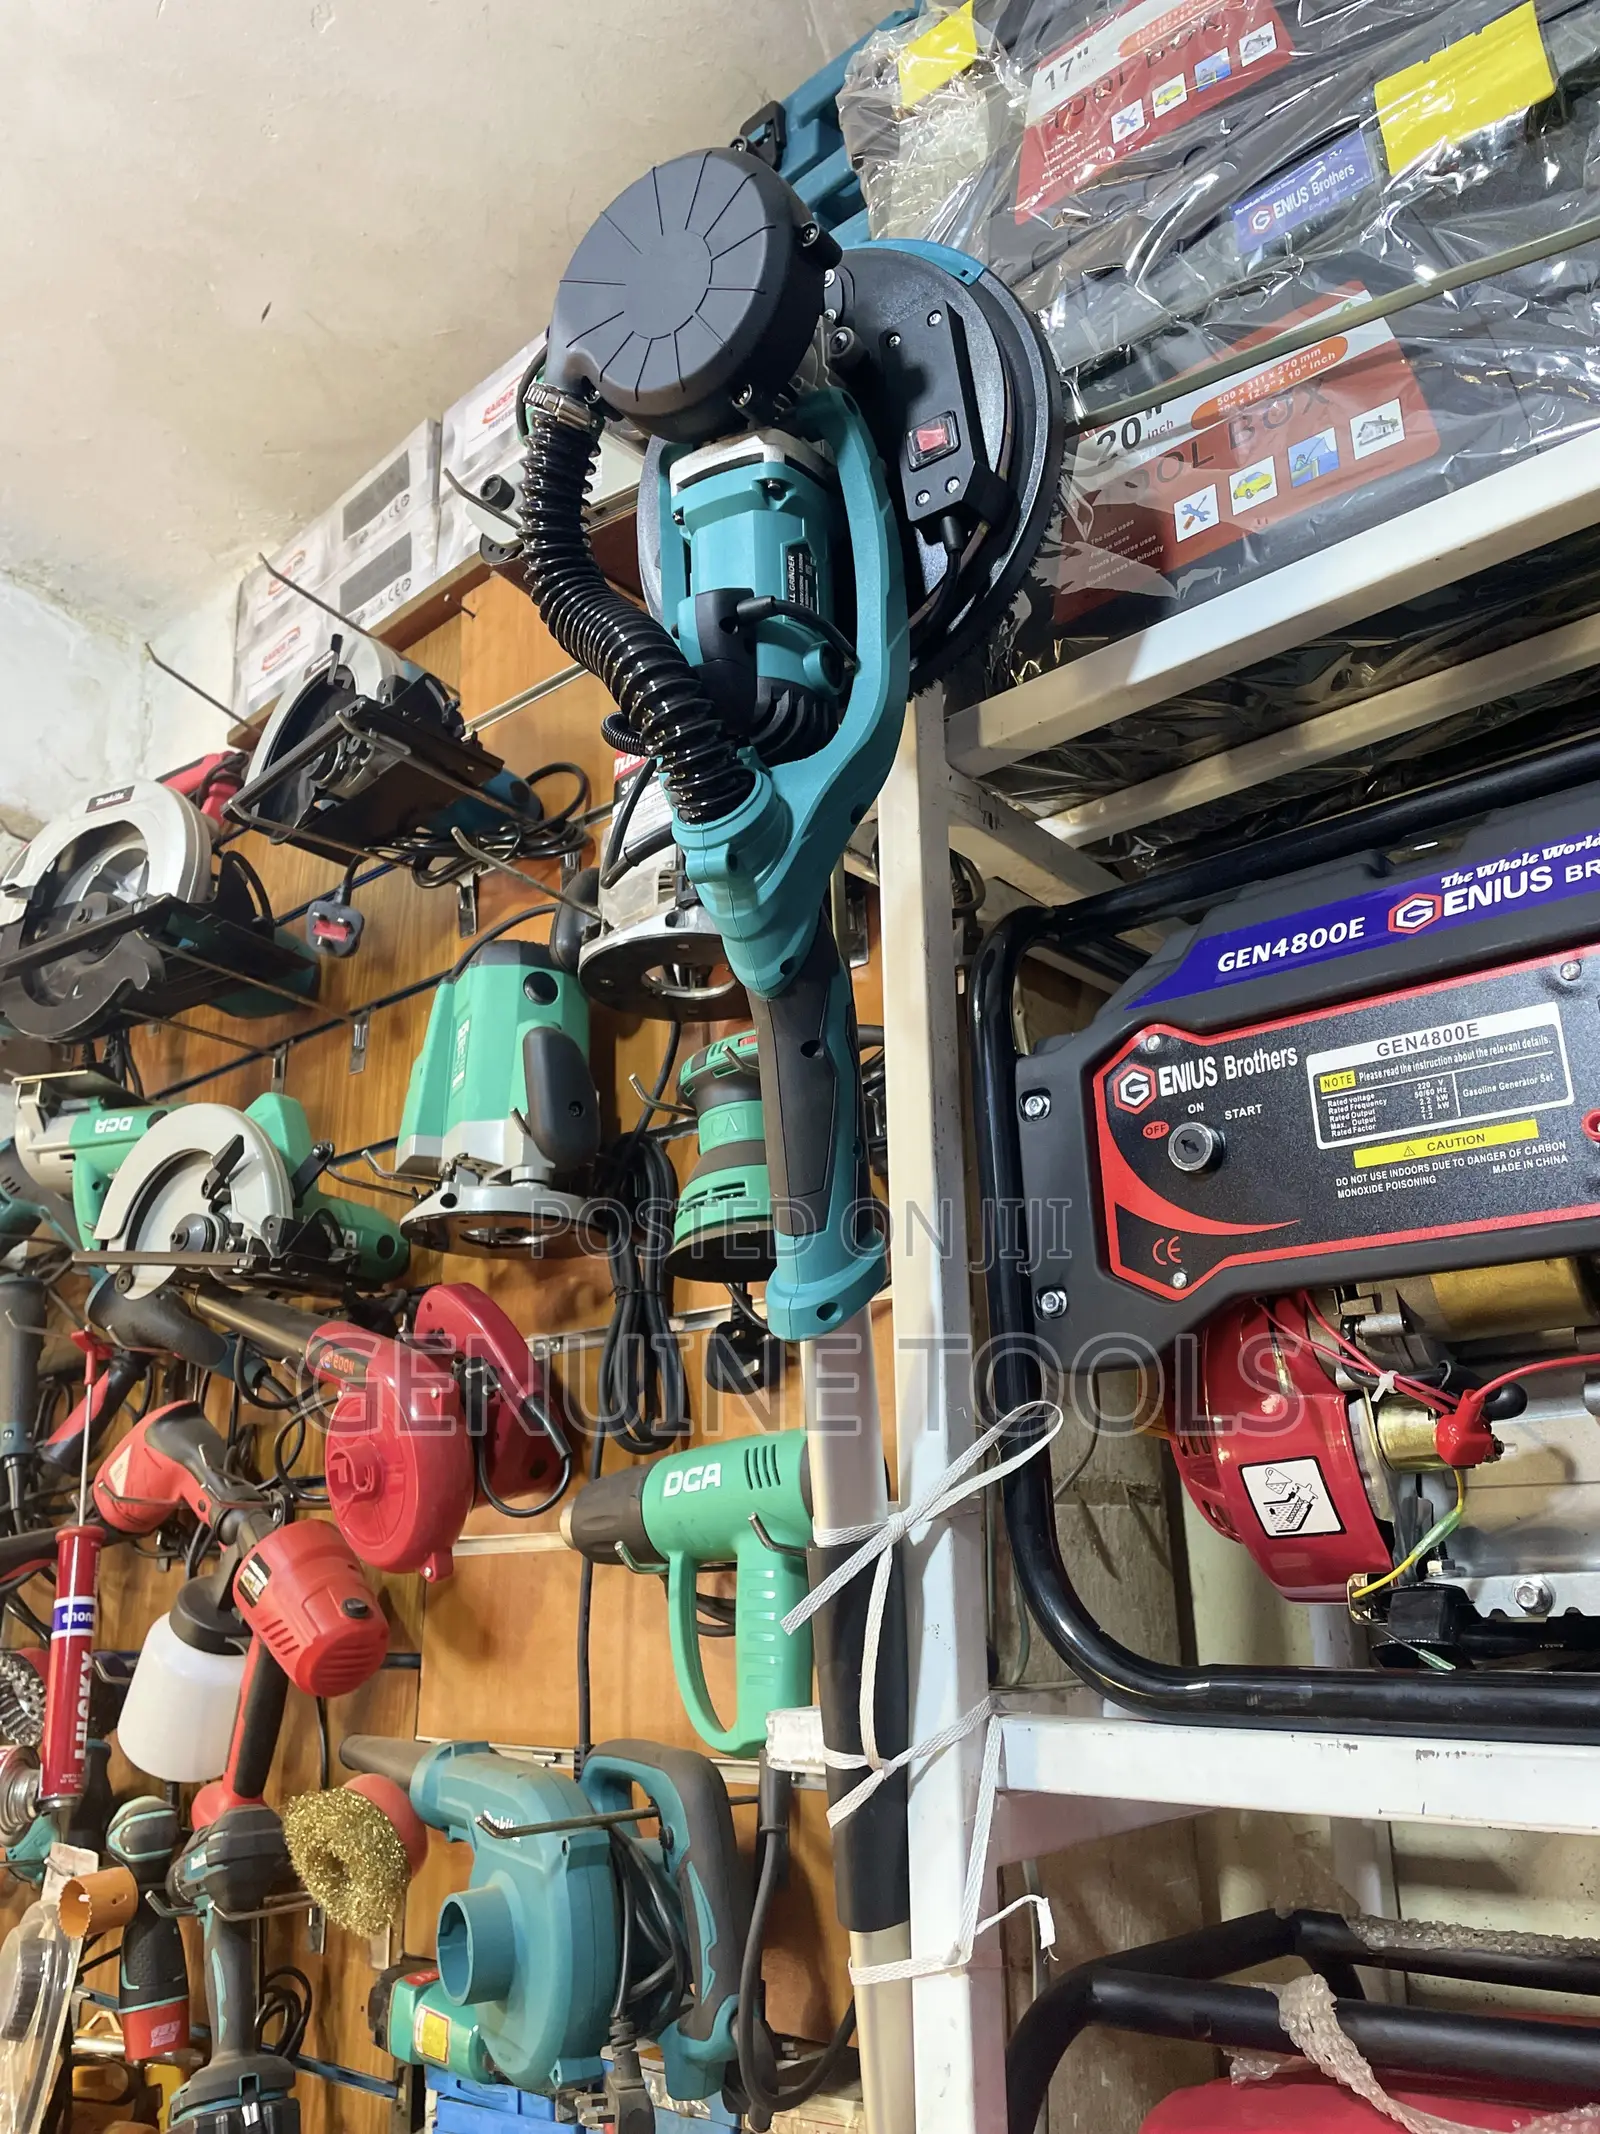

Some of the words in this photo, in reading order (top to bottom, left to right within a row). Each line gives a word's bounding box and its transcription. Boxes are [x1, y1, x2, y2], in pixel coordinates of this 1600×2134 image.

[1044, 45, 1089, 91] 17"
[1252, 186, 1309, 230] GENIUS
[1311, 164, 1355, 196] Brothers
[1217, 388, 1236, 406] 500
[1238, 386, 1245, 395] x
[1248, 374, 1266, 392] 311
[1268, 371, 1276, 380] x
[1278, 359, 1298, 377] 270
[1299, 347, 1321, 365] mm
[1278, 376, 1286, 385] x
[1148, 419, 1174, 439] inch
[1116, 519, 1135, 532] uses
[1112, 534, 1130, 547] uses
[1140, 534, 1157, 546] uses
[788, 555, 796, 591] GRINDER
[1441, 871, 1474, 889] The
[1476, 852, 1540, 879] Whole
[1395, 865, 1553, 929] GENIUS
[1218, 916, 1365, 972] GEN4800E
[1376, 1022, 1480, 1057] GEN4800E
[1324, 1074, 1353, 1089] NOTE
[1359, 1069, 1383, 1083] Please
[1383, 1065, 1399, 1079] read
[1399, 1063, 1411, 1075] the
[1412, 1054, 1452, 1073] instruction
[1453, 1051, 1475, 1065] about
[1475, 1048, 1488, 1060] the
[1489, 1041, 1521, 1057] relevant
[1522, 1036, 1551, 1050] details.
[1119, 1056, 1218, 1107] GENIUS
[1223, 1047, 1298, 1080] Brothers
[1462, 1085, 1497, 1098] Gasoline
[1499, 1078, 1538, 1091] Generator
[1540, 1074, 1554, 1085] Set
[1327, 1098, 1348, 1107] Rated
[1349, 1093, 1375, 1104] voltage
[1417, 1081, 1431, 1090] 220
[1328, 1105, 1349, 1115] Rated
[1350, 1099, 1387, 1111] Frequency
[1414, 1089, 1435, 1099] 50/60
[1187, 1102, 1205, 1114] ON
[1224, 1103, 1263, 1121] START
[1329, 1113, 1350, 1122] Rated
[1351, 1109, 1375, 1119] Output
[1419, 1097, 1431, 1105] 2.2
[1351, 1116, 1376, 1126] Output
[1420, 1105, 1432, 1113] 2.5
[95, 1116, 133, 1134] DCA
[1145, 1123, 1166, 1136] OFF
[1331, 1128, 1352, 1137] Rated
[1352, 1124, 1376, 1133] Factor
[1427, 1133, 1486, 1152] CAUTION
[1336, 1177, 1348, 1187] DO
[1350, 1173, 1369, 1185] NOT
[1370, 1170, 1388, 1182] USE
[1389, 1163, 1431, 1178] INDOORS
[1432, 1159, 1451, 1171] DUE
[1452, 1157, 1465, 1167] TO
[1467, 1151, 1507, 1166] DANGER
[1509, 1148, 1522, 1158] OF
[1524, 1140, 1567, 1156] CARBON
[1492, 1162, 1521, 1174] MADE
[1522, 1160, 1534, 1170] IN
[1535, 1154, 1568, 1168] CHINA
[1337, 1184, 1384, 1199] MONOXIDE
[1385, 1175, 1437, 1192] POISONING
[663, 1462, 721, 1497] DCA
